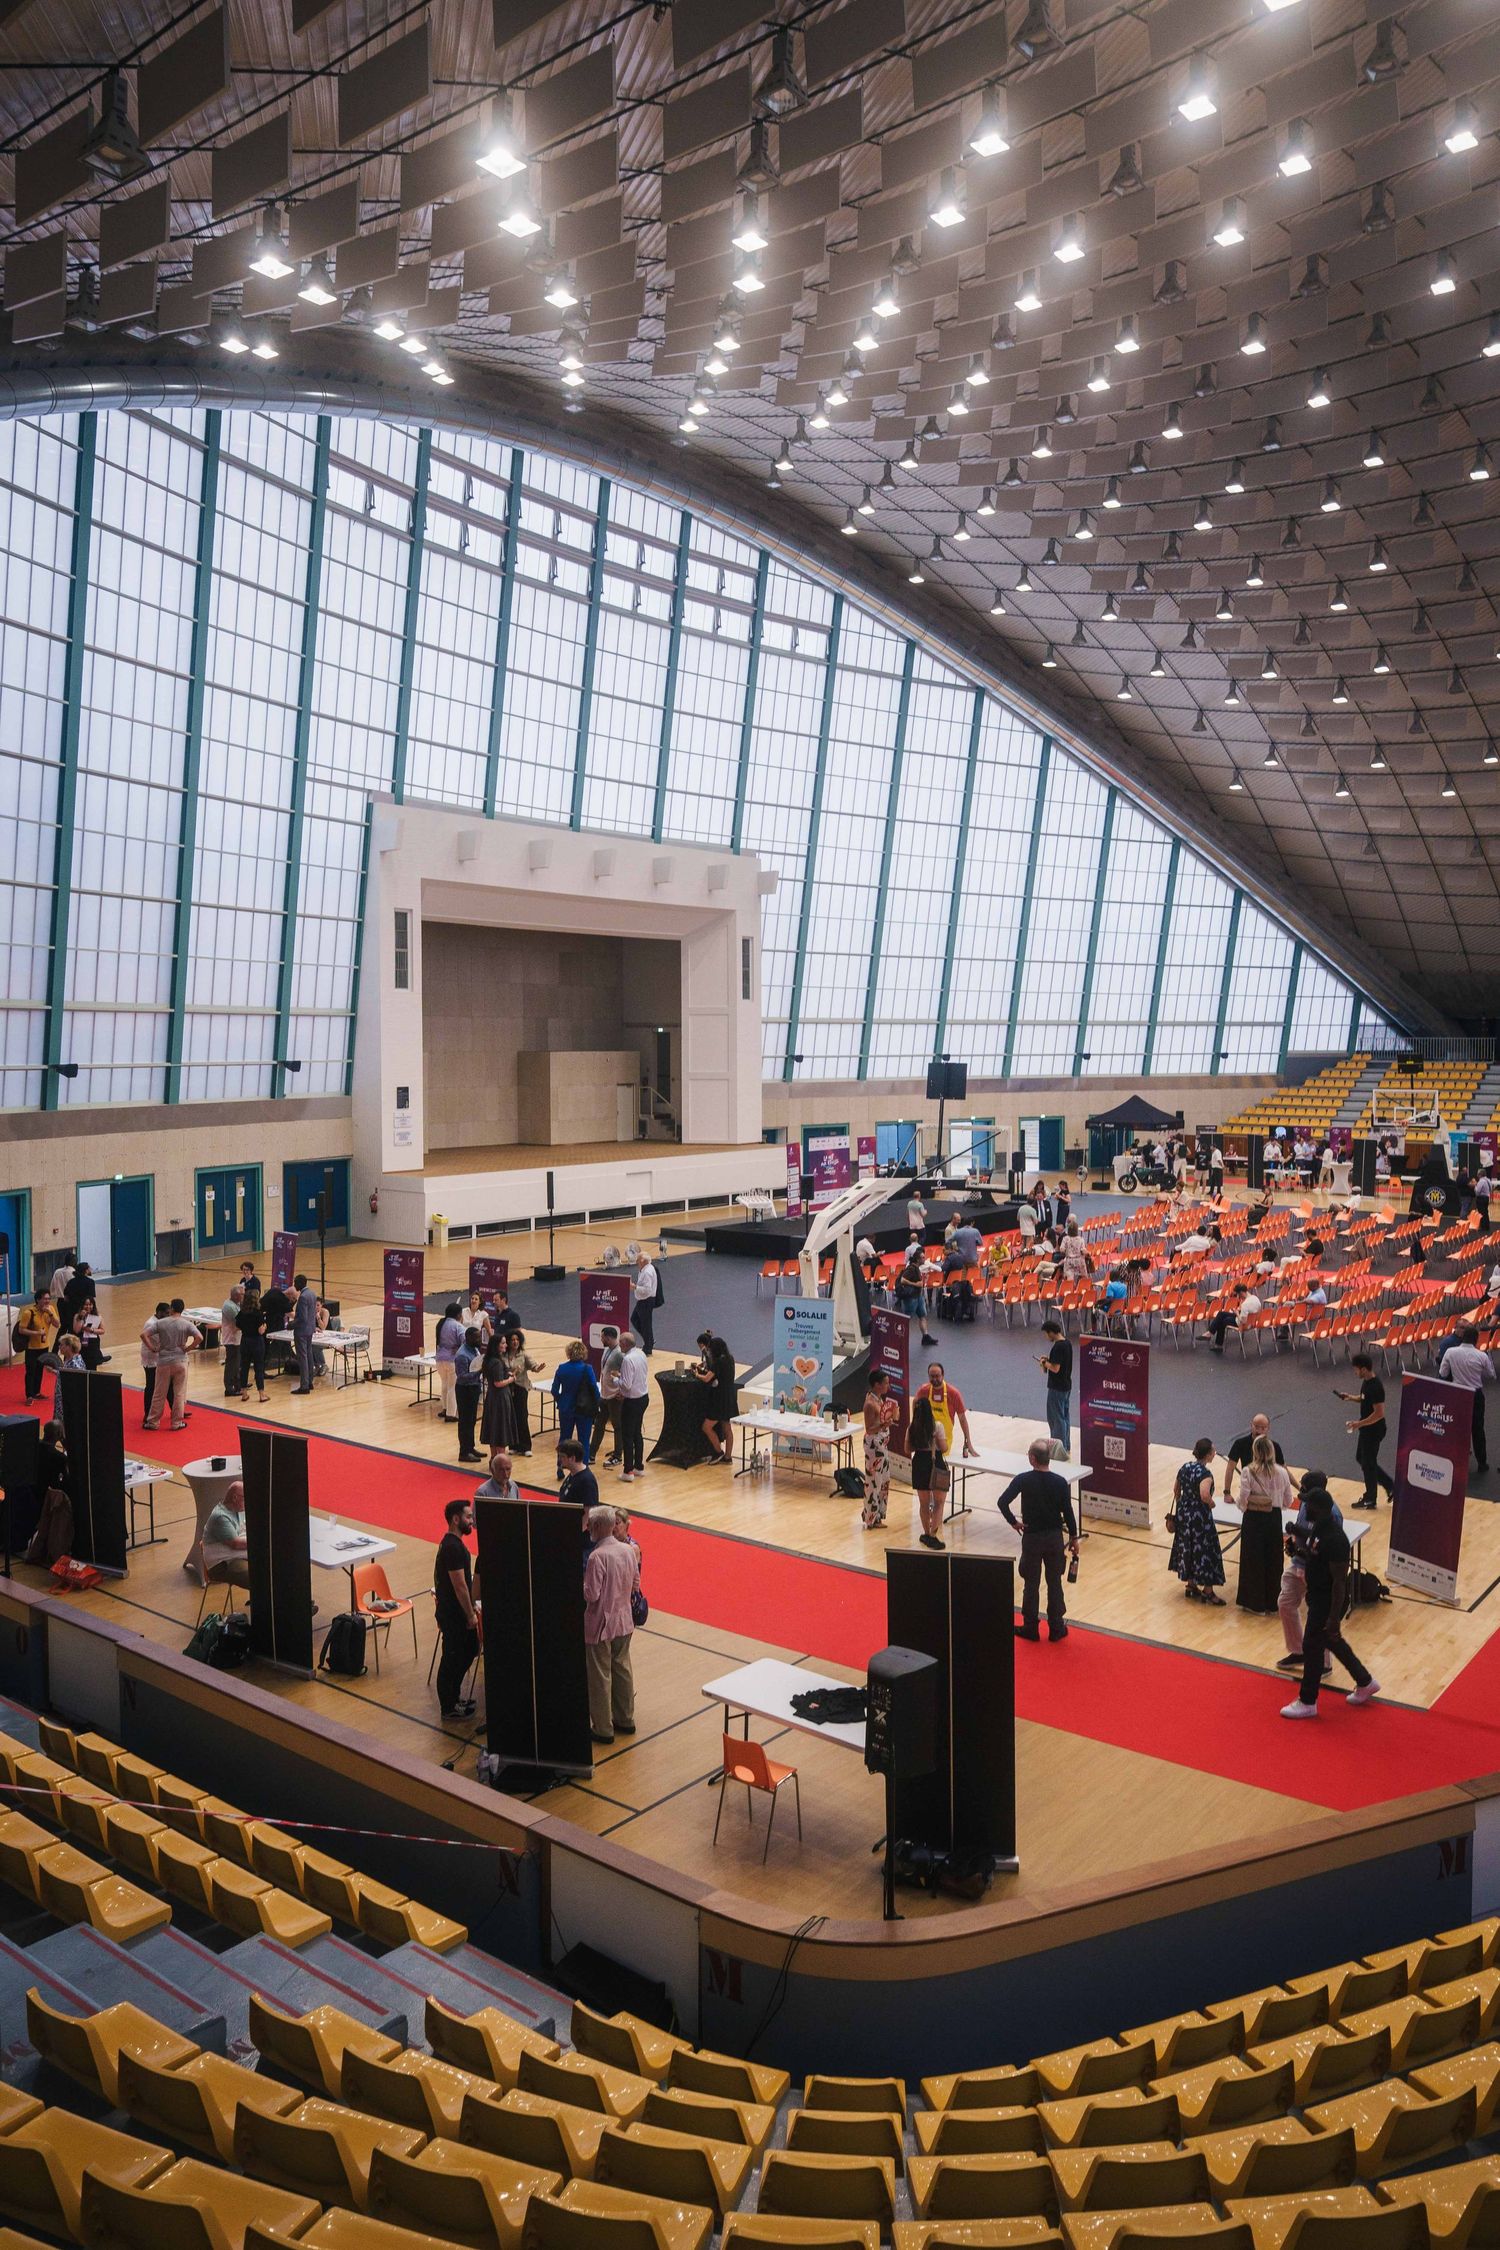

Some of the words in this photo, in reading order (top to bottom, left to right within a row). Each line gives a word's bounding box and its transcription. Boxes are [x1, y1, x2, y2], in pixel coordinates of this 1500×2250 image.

[796, 1311, 827, 1320] SOLALIE
[1102, 1379, 1127, 1391] Basile
[1423, 1402, 1431, 1411] LA
[1436, 1836, 1468, 1881] M
[705, 1949, 745, 2006] M
